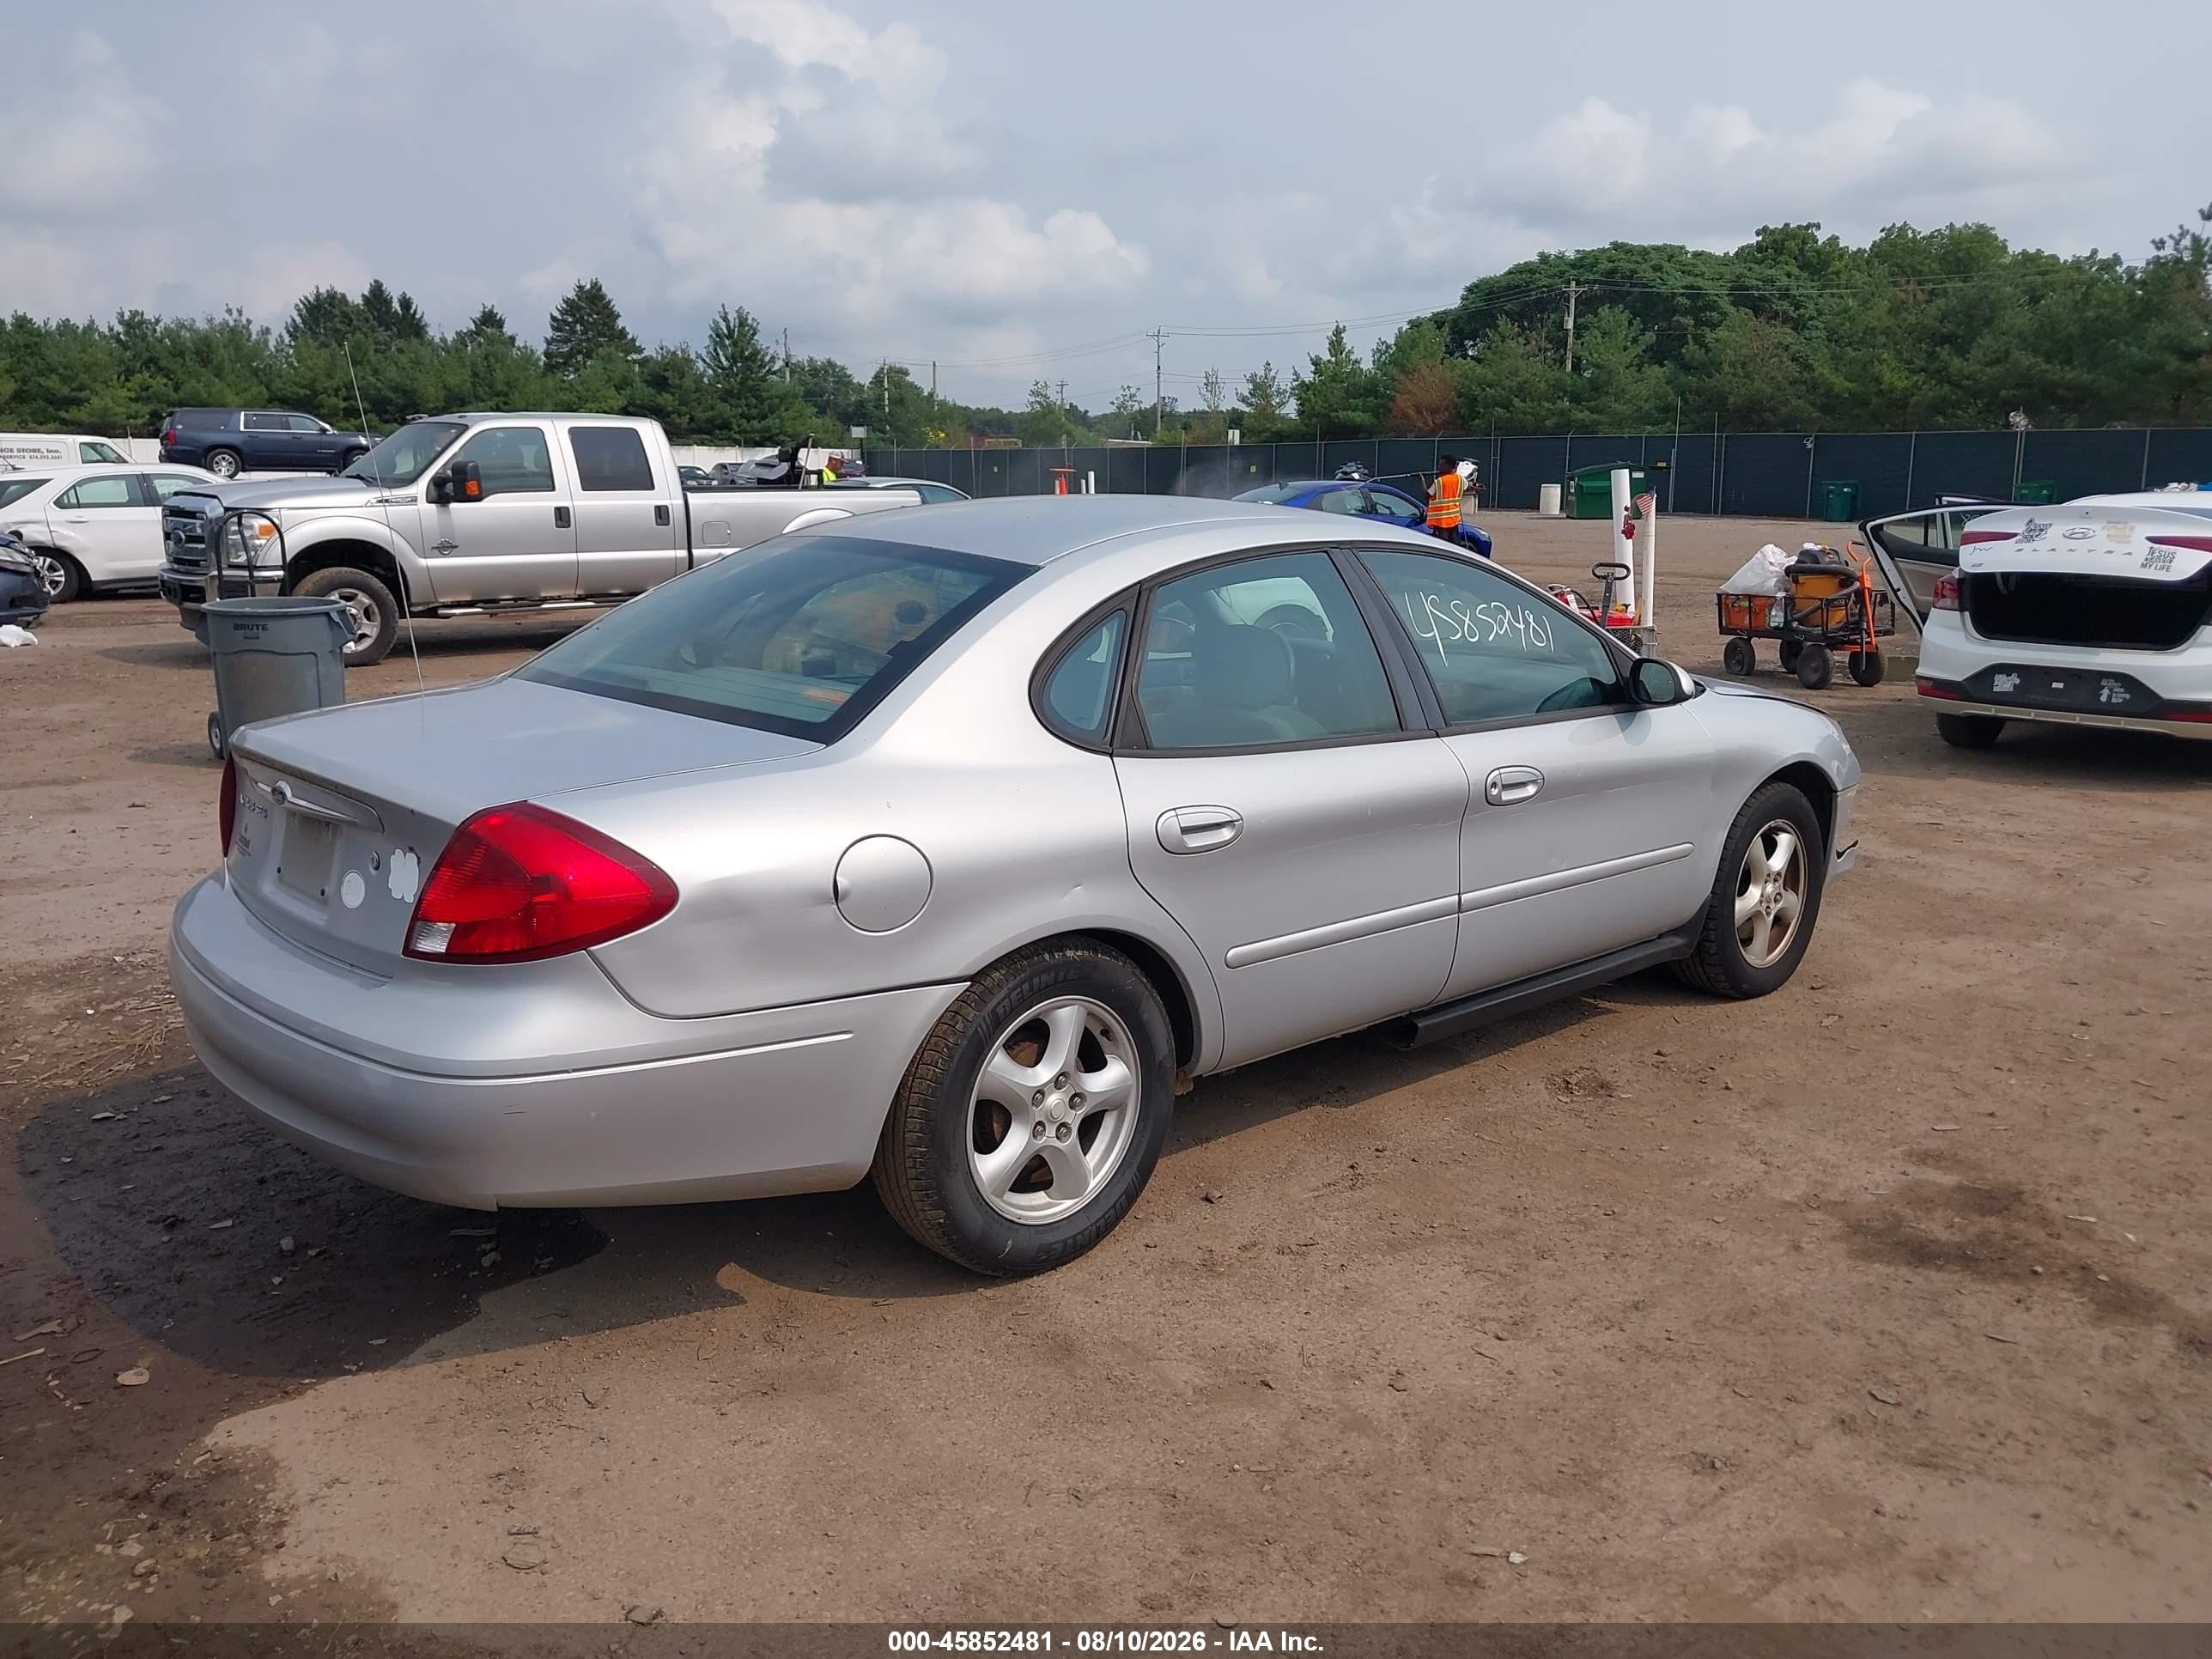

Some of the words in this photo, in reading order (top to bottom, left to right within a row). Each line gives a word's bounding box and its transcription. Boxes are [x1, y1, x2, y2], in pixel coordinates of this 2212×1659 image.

[2145, 546, 2178, 560] JESUS
[2139, 562, 2154, 570] MY
[2154, 563, 2173, 573] LIFE
[233, 623, 269, 632] BRUTE
[1404, 590, 1554, 667] 45852481
